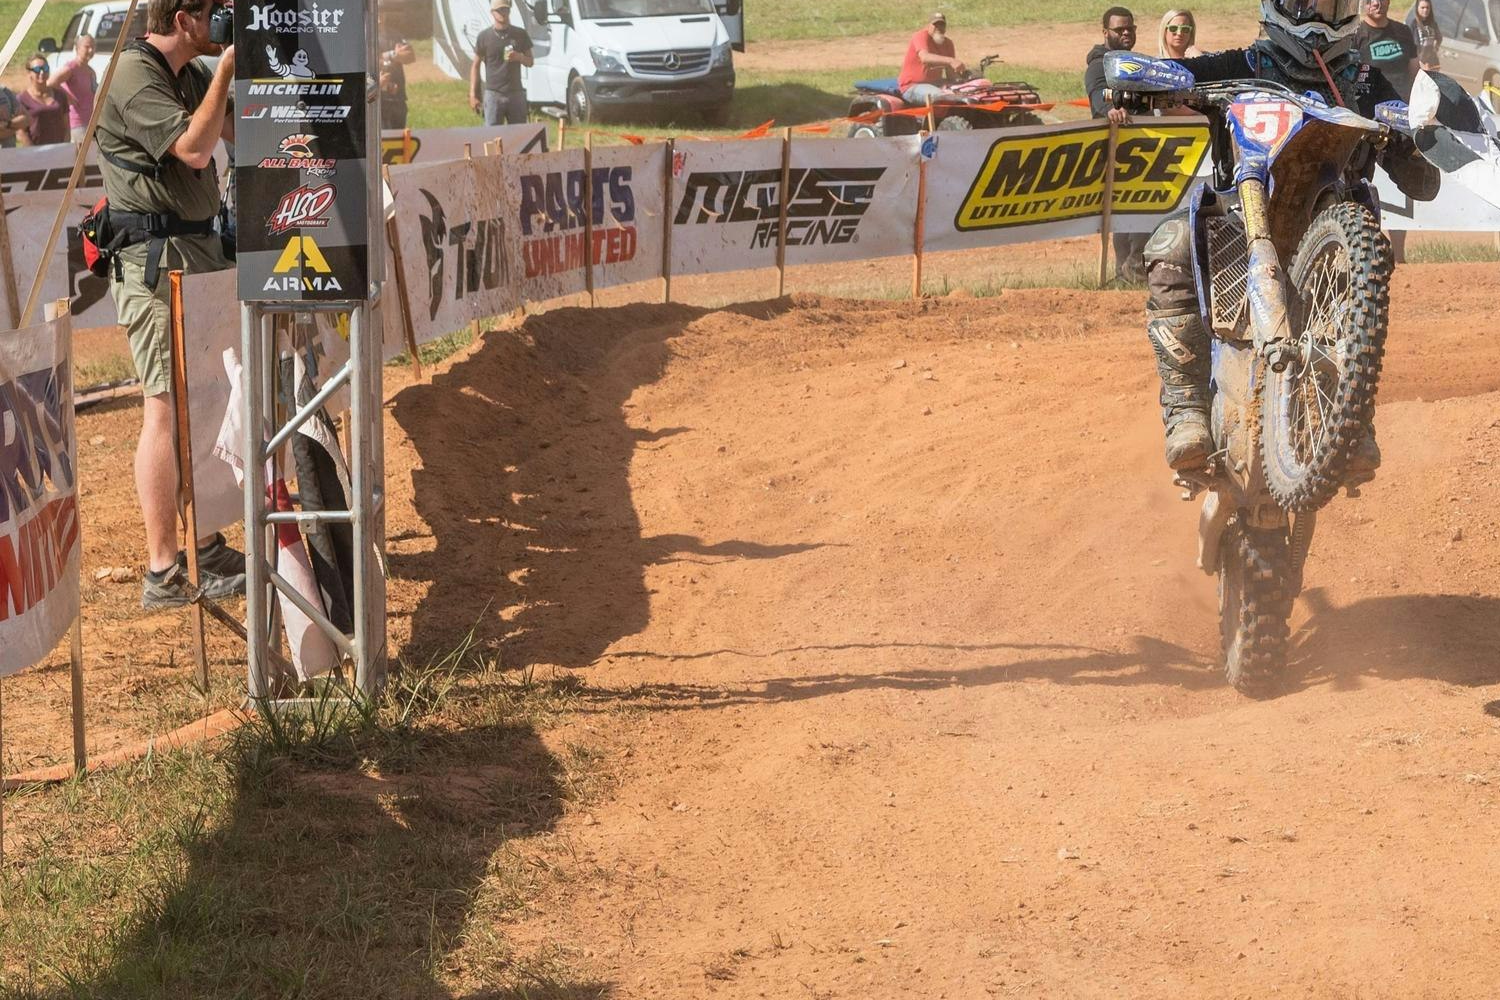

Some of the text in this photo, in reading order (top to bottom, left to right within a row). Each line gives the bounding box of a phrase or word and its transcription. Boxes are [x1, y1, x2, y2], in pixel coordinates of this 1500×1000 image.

[246, 2, 344, 30] Hoosier
[248, 84, 343, 95] MICHELIN
[257, 158, 336, 169] ALL BALLS
[981, 137, 1196, 198] MOOSE
[969, 199, 1057, 220] UTILITY
[263, 277, 342, 291] ARMA
